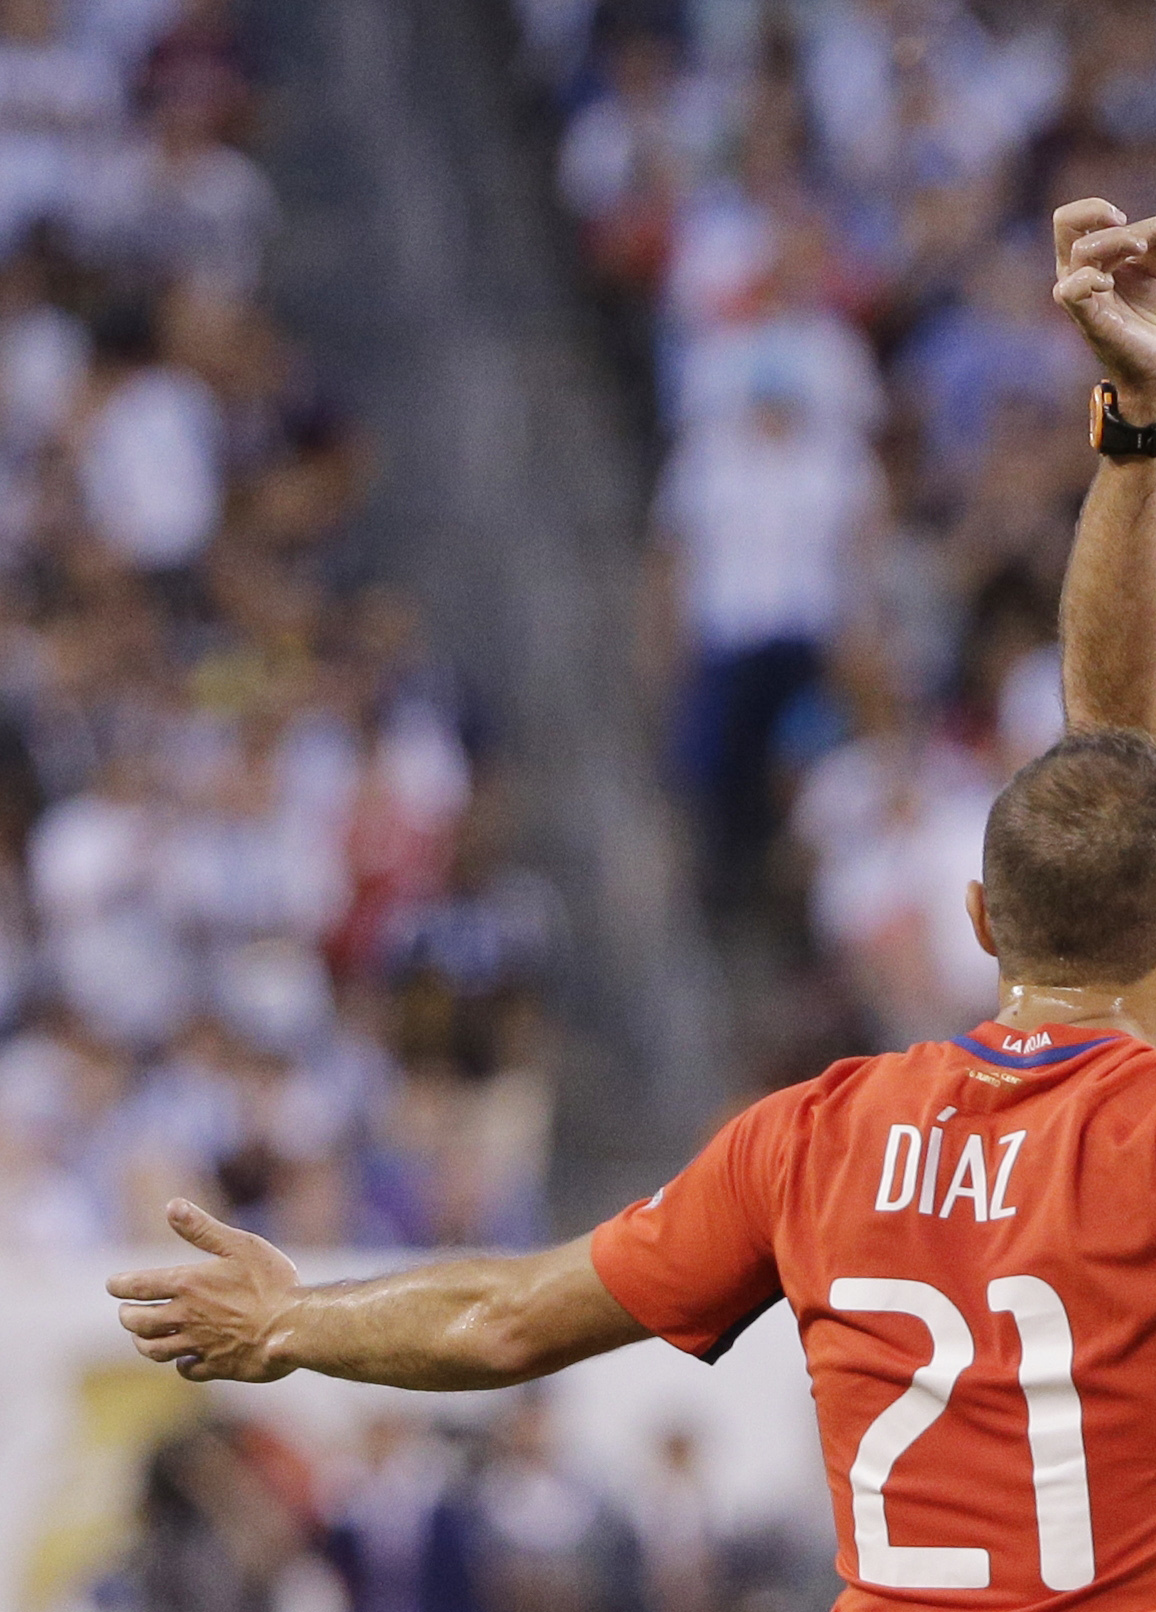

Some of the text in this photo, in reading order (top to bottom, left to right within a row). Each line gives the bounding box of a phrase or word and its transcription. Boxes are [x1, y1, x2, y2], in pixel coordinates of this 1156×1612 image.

[1002, 1034, 1023, 1054] LA
[875, 1105, 1027, 1222] DÍAZ
[829, 1275, 1095, 1591] 21
